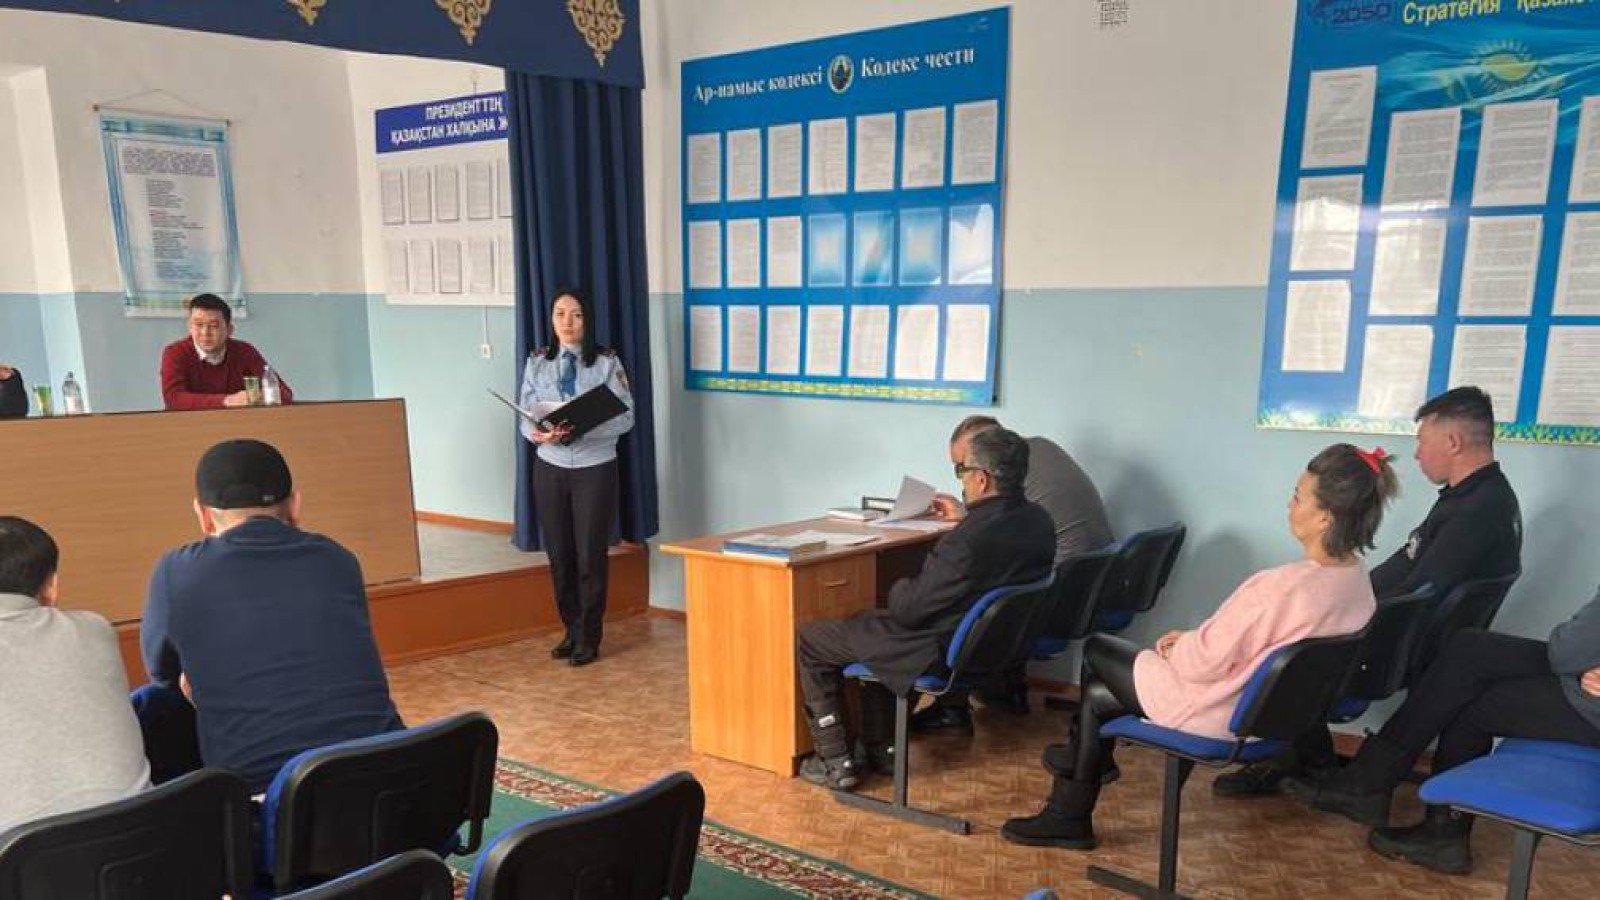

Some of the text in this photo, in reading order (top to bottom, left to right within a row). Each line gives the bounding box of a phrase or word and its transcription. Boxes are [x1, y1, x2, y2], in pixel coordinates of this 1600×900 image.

[861, 47, 975, 77] Кодекс чести
[694, 66, 823, 104] Ар-намыс кодексі
[391, 126, 445, 146] ҚАЗАҚСТАН
